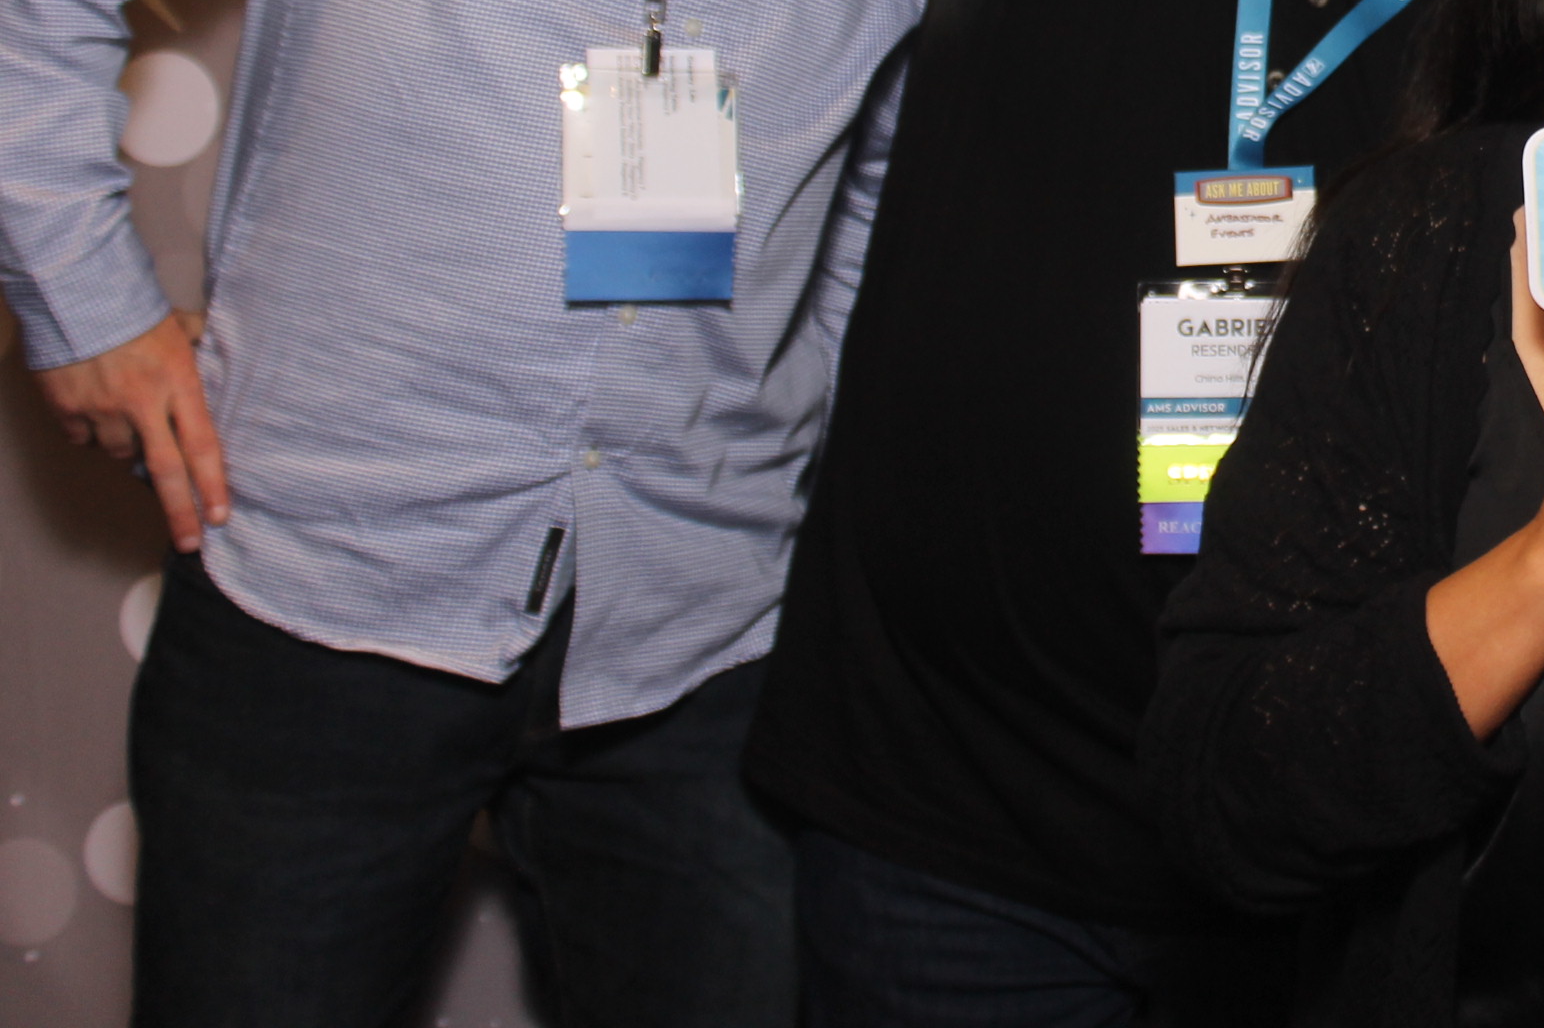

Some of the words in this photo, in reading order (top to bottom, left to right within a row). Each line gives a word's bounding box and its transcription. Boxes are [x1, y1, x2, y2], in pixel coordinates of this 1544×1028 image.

[1235, 33, 1264, 121] ADVISOR
[1243, 72, 1312, 142] ADVISOR
[1206, 183, 1226, 199] ASK
[1228, 182, 1243, 197] ME
[1246, 180, 1280, 197] ABOUT
[1177, 318, 1270, 337] GABRIE
[1146, 403, 1172, 413] AMS
[1175, 403, 1226, 413] ADVISOR
